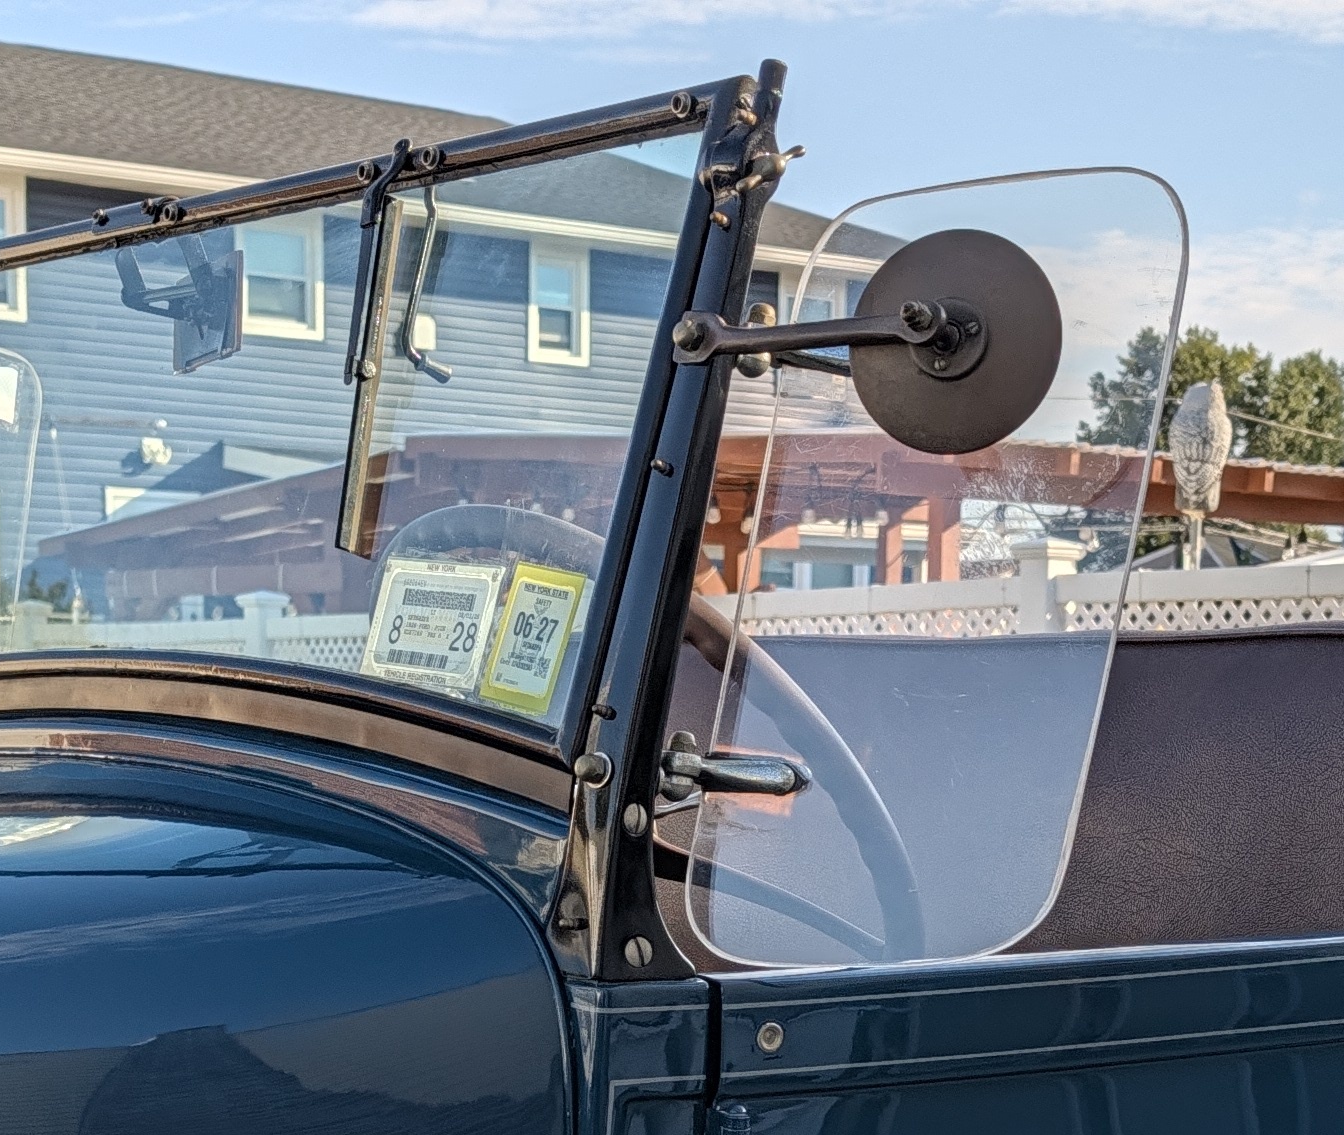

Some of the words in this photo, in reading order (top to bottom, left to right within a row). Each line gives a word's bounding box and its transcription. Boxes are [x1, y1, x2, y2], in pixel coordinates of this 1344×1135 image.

[427, 563, 440, 571] NEW
[441, 564, 457, 573] YORK
[523, 582, 536, 593] NEW
[537, 585, 551, 596] YORK
[551, 588, 569, 600] STATE
[535, 597, 553, 607] SAFETY
[388, 614, 404, 644] 8
[448, 621, 478, 652] 28
[513, 611, 535, 638] 06
[535, 617, 559, 644] 27
[384, 669, 407, 679] VEHICLE
[407, 672, 447, 684] REGISTRATION
